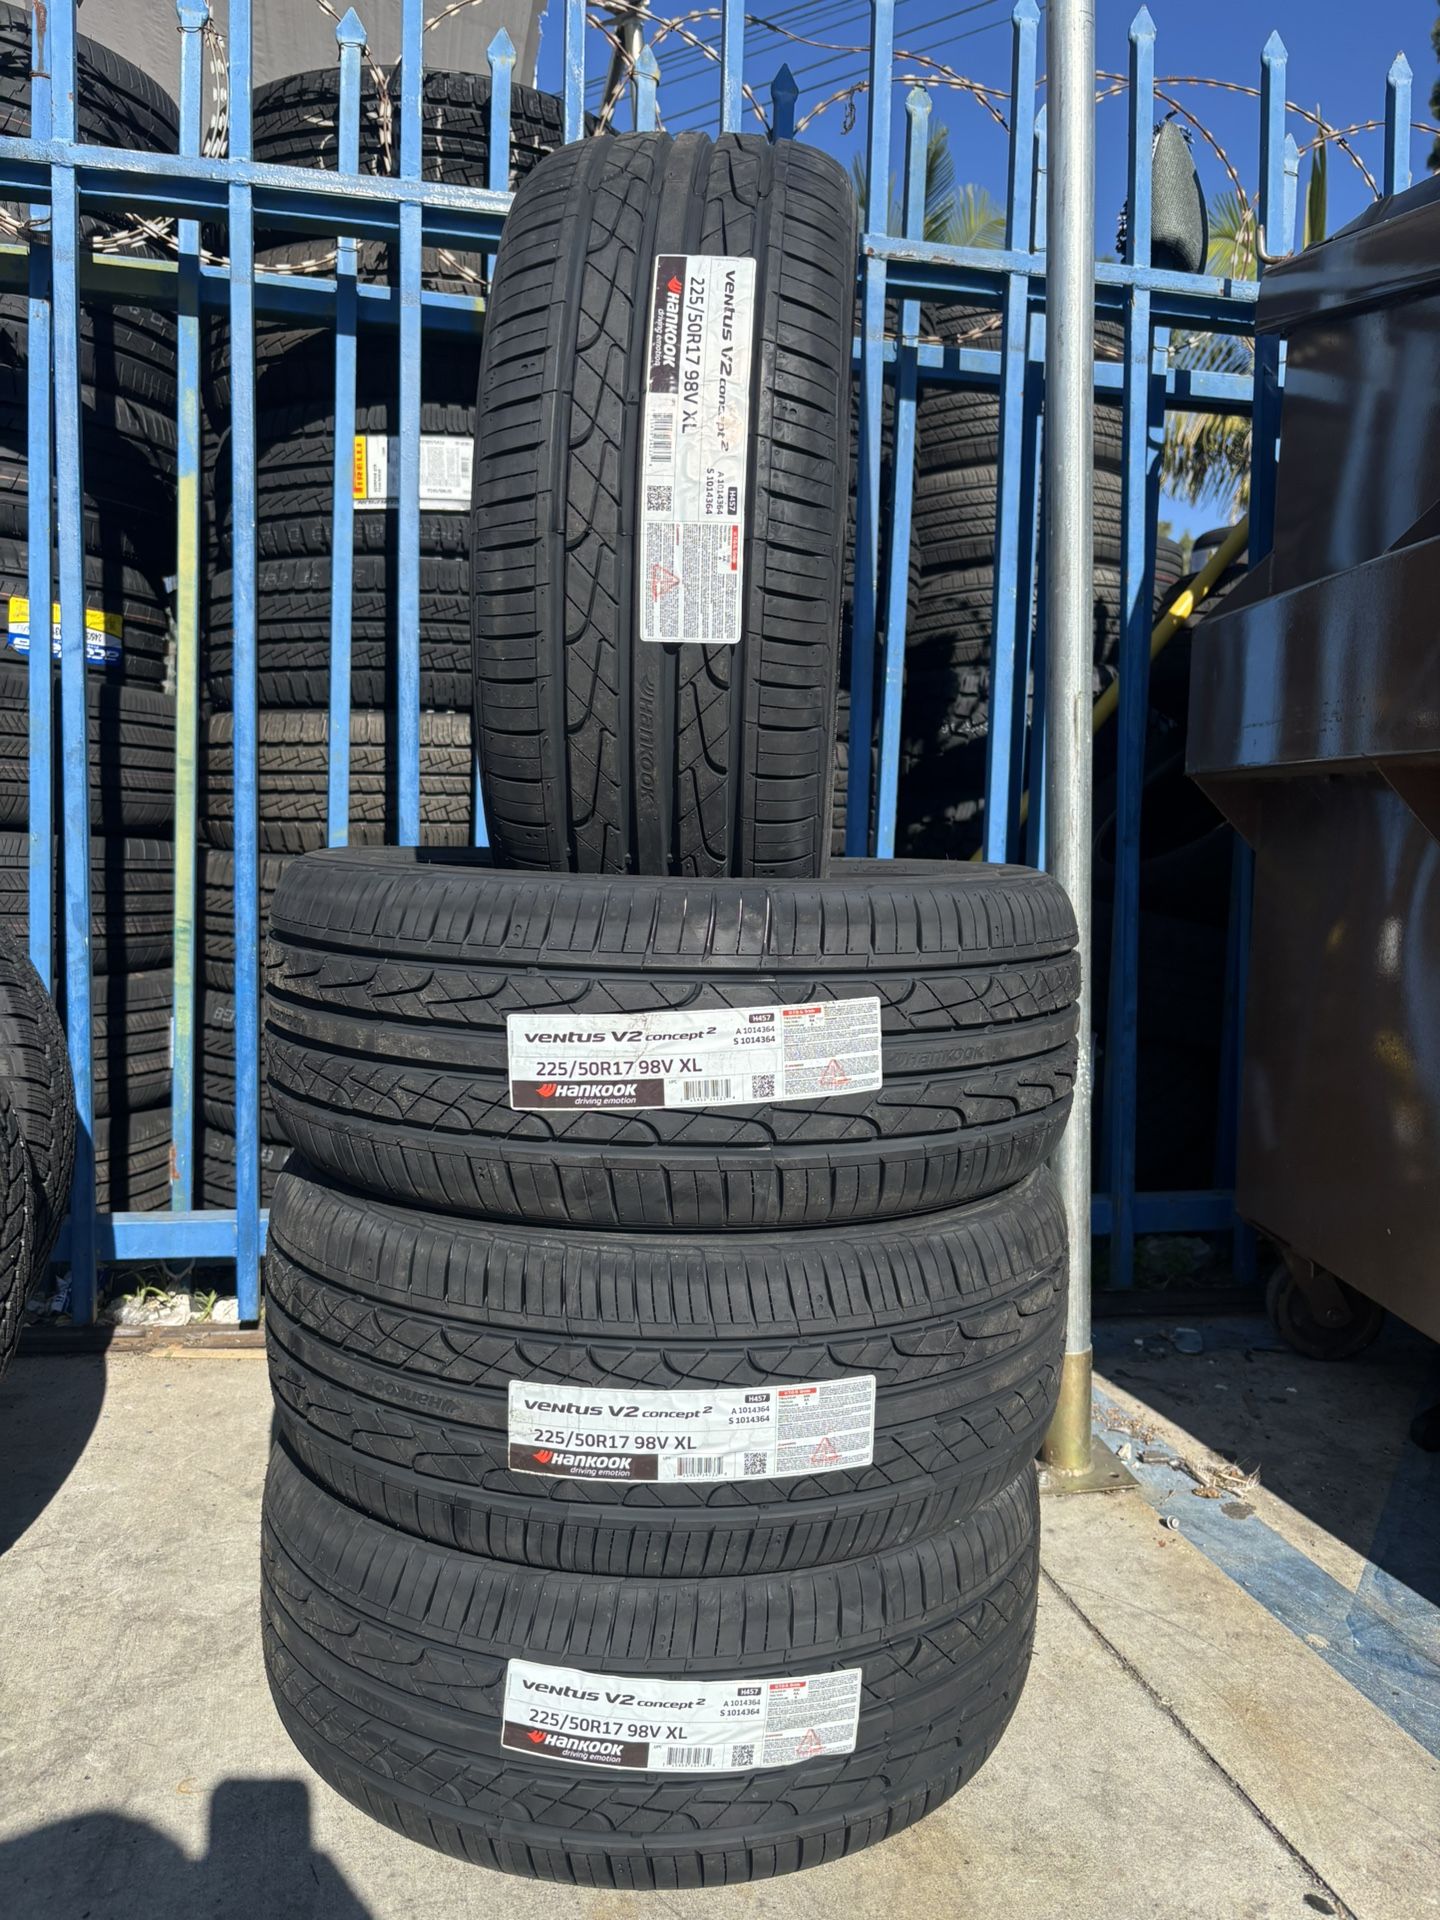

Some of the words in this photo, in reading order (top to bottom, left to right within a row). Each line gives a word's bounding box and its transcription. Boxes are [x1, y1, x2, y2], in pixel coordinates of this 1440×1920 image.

[654, 308, 664, 334] driving
[685, 277, 705, 367] 225/50R17
[654, 335, 662, 367] emotion
[719, 346, 734, 377] V2
[684, 370, 699, 405] 98V
[681, 409, 698, 434] XL
[705, 476, 714, 515] 1014364
[752, 1014, 771, 1023] H457
[611, 1031, 643, 1042] V2
[743, 1026, 775, 1034] 1014364
[741, 1036, 776, 1045] 1014364
[536, 1060, 634, 1079] 225/50R17
[638, 1059, 674, 1074] 98V
[679, 1058, 703, 1073] XL
[575, 1097, 602, 1106] driving
[748, 1394, 767, 1402] H457
[608, 1405, 640, 1418] V2
[731, 1407, 738, 1415] A
[739, 1405, 770, 1414] 1014364
[728, 1417, 734, 1425] S
[736, 1415, 770, 1424] 1014364
[533, 1428, 630, 1449] 225/50R17
[634, 1436, 669, 1450] 98V
[674, 1436, 697, 1450] XL
[570, 1466, 597, 1476] driving
[598, 1469, 631, 1477] emotion
[740, 1688, 759, 1696] H457
[605, 1692, 636, 1706] V2
[730, 1699, 761, 1707] 1014364
[727, 1708, 760, 1717] 1014364
[529, 1708, 624, 1736] 225/50R17
[627, 1723, 661, 1738] 98V
[666, 1726, 688, 1739] XL
[562, 1749, 588, 1761] driving
[589, 1753, 621, 1763] emotion
